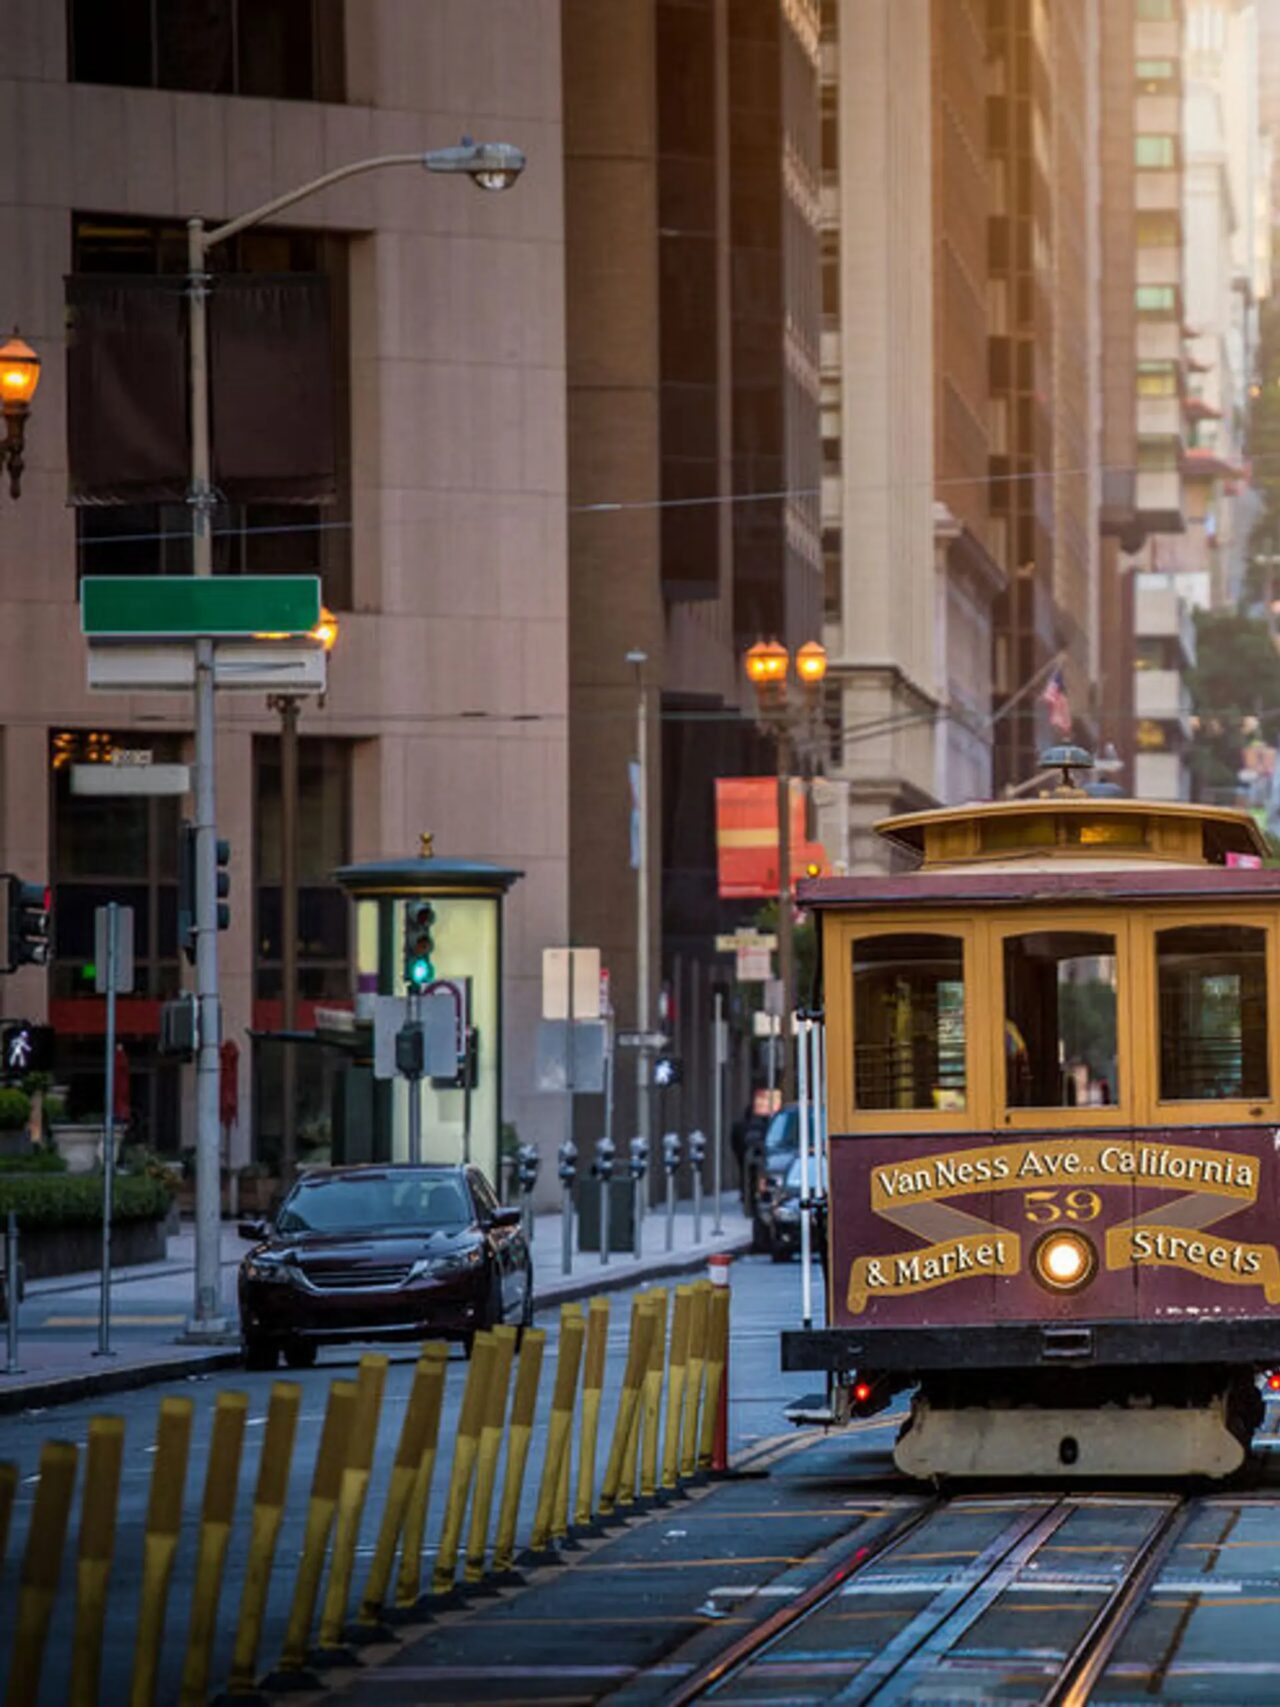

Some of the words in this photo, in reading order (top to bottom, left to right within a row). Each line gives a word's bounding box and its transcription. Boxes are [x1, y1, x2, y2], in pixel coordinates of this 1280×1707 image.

[879, 1169, 932, 1197] Van
[934, 1157, 1010, 1187] Ness
[1099, 1147, 1253, 1187] California
[1024, 1189, 1102, 1223] 59
[866, 1259, 889, 1288] &
[894, 1240, 1006, 1286] Market
[1131, 1230, 1263, 1275] Streets
